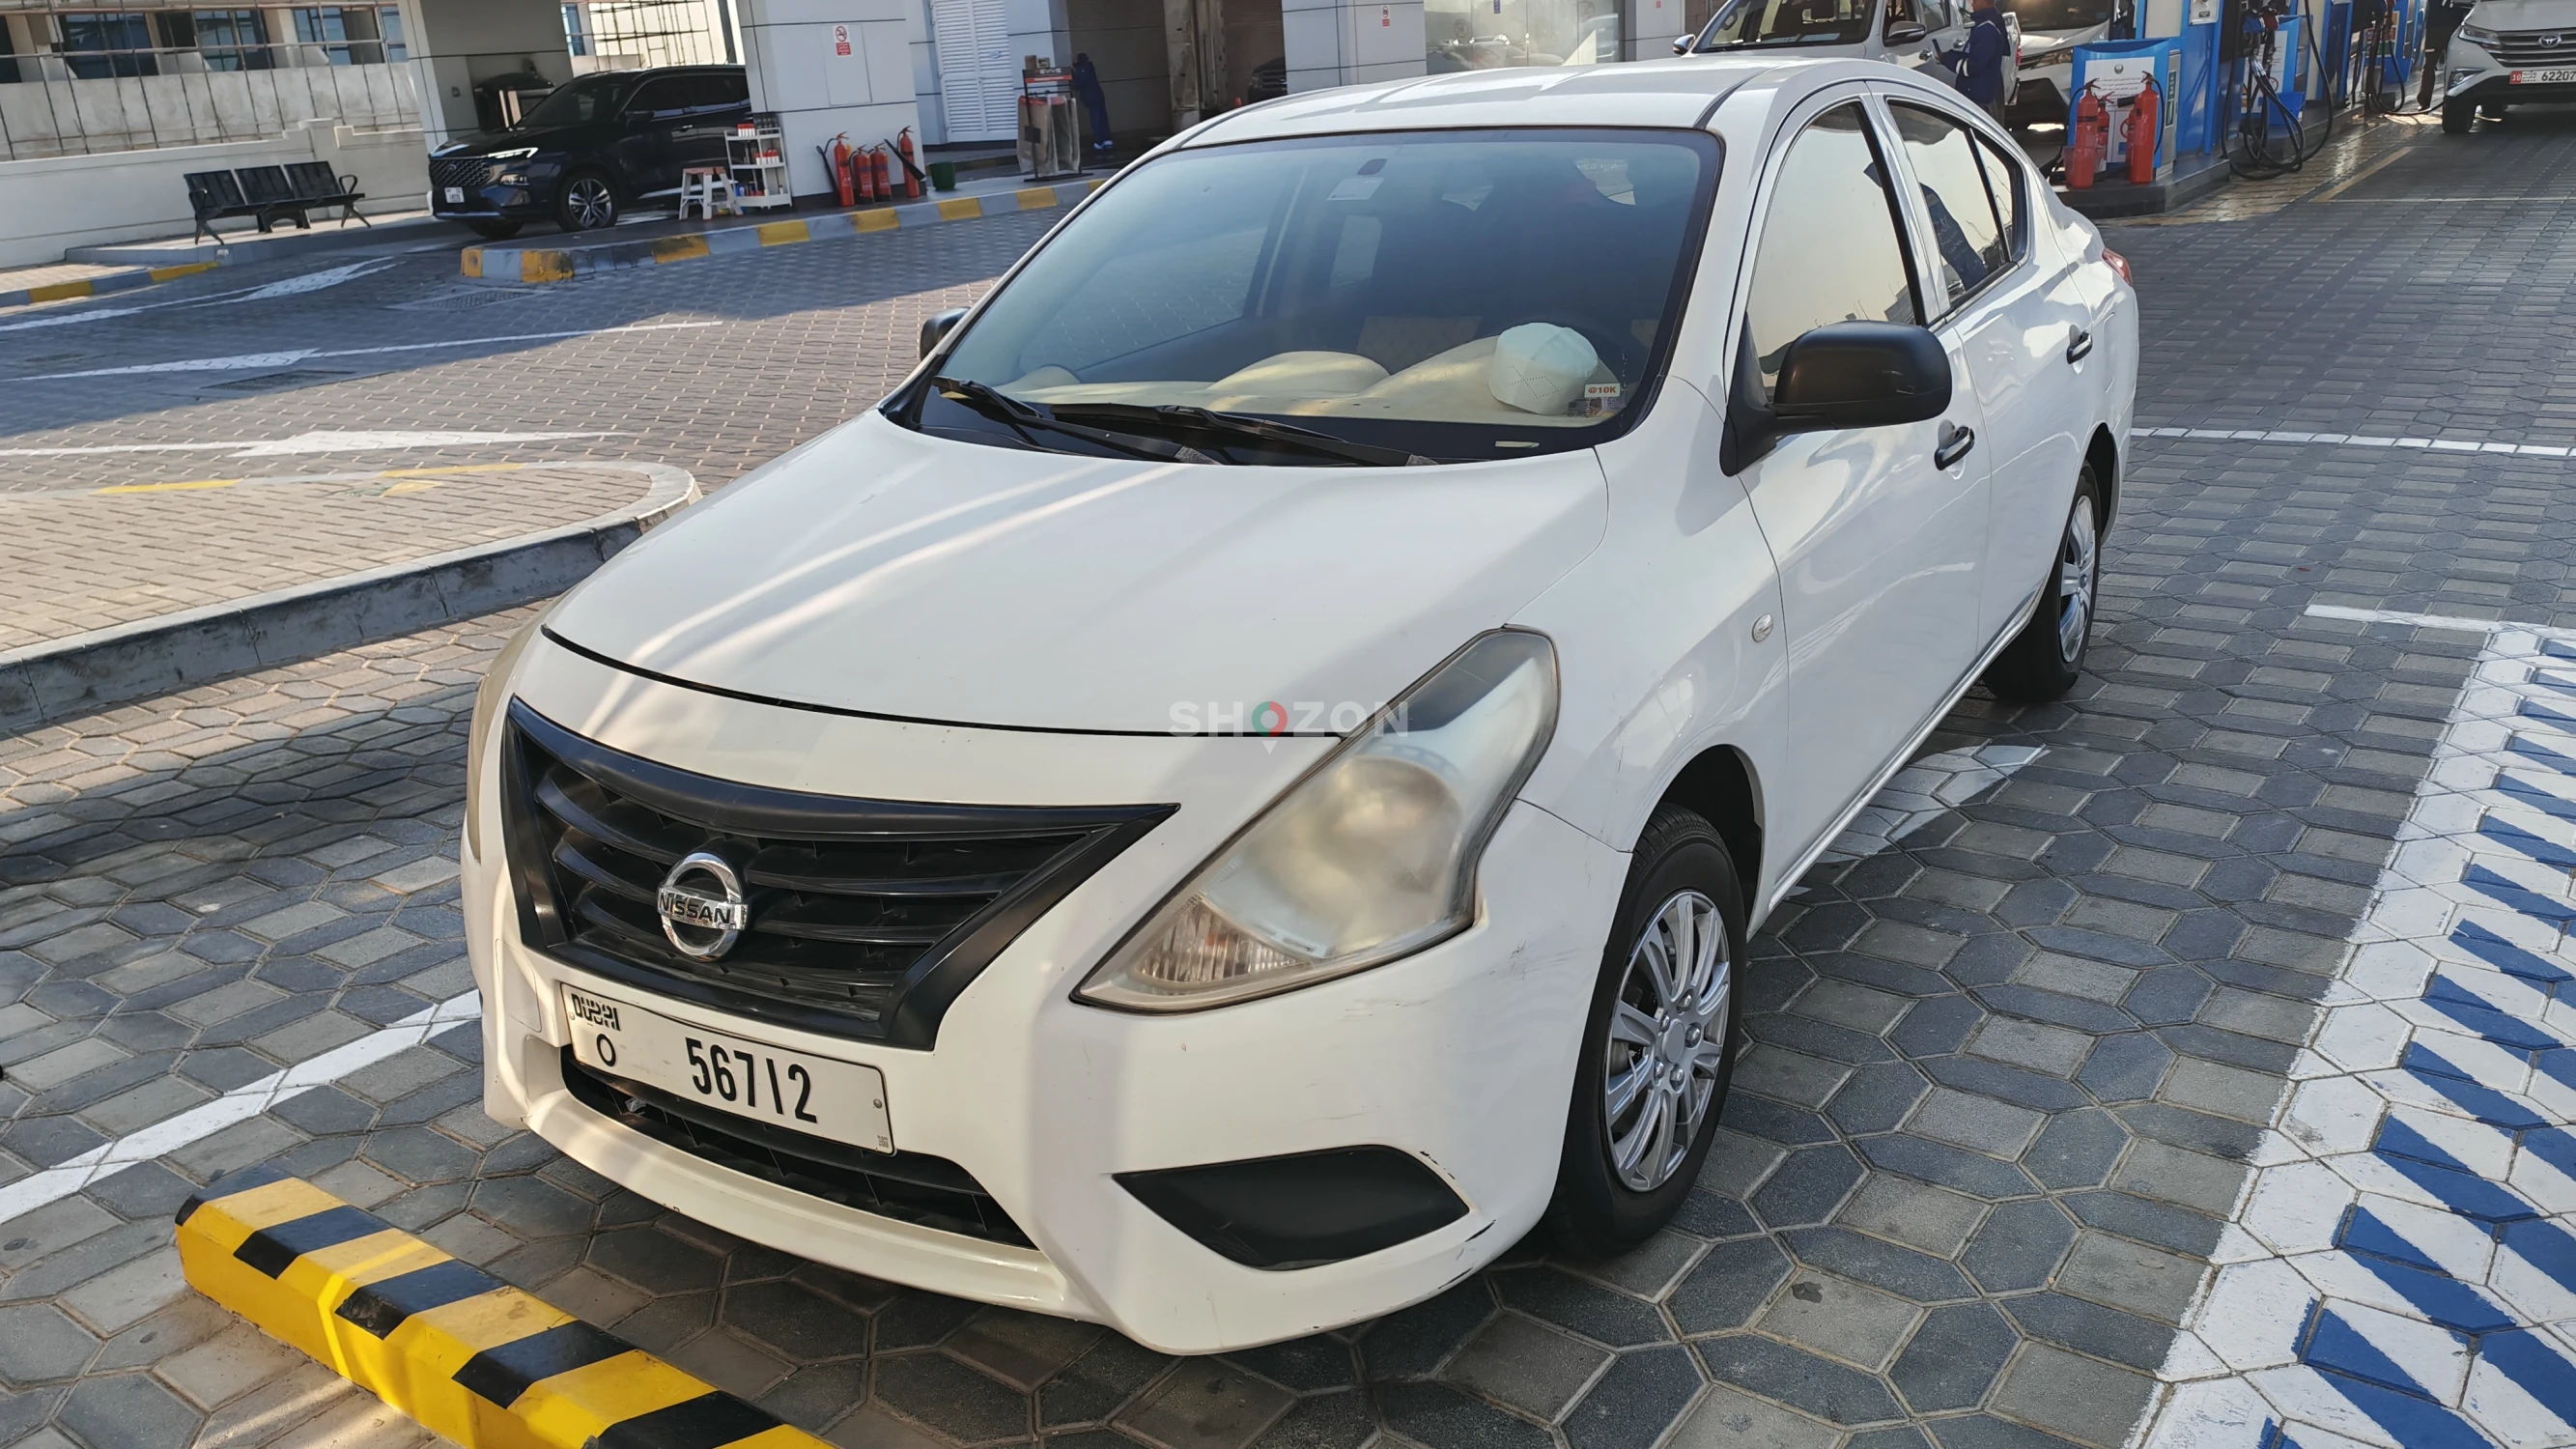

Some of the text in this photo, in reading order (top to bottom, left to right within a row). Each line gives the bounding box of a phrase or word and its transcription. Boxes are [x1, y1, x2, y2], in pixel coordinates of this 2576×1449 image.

[2541, 71, 2576, 82] 62207
[659, 892, 731, 924] NISSAN
[571, 992, 621, 1032] DUBAI
[596, 1033, 617, 1067] O
[685, 1037, 818, 1124] 56712
